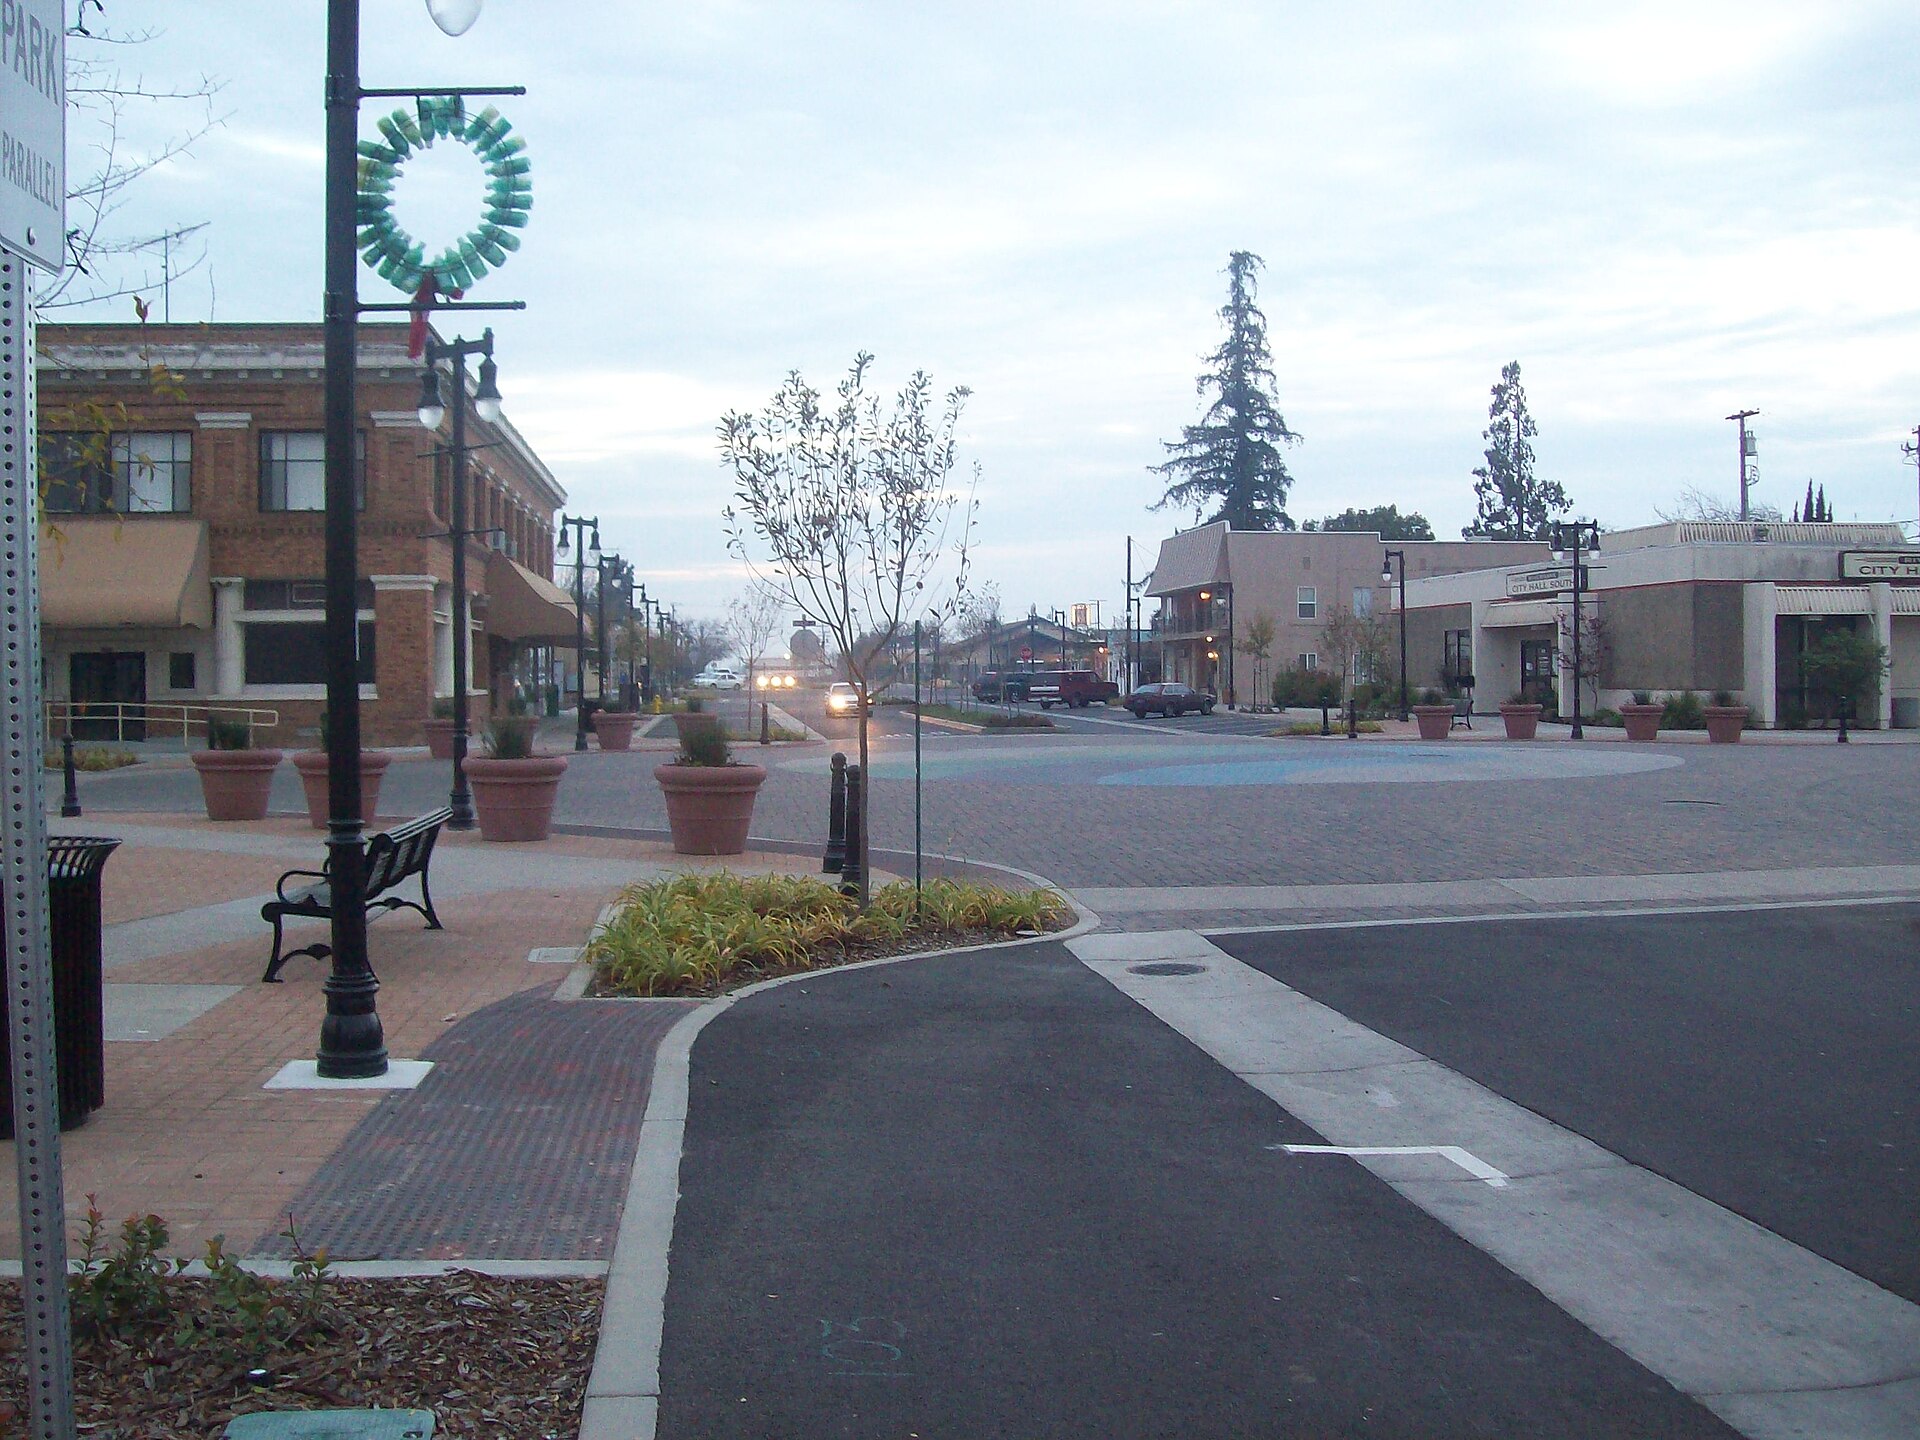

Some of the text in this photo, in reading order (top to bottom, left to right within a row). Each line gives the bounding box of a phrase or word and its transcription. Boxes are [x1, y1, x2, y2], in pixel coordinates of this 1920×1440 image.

[2, 0, 58, 106] PARK
[2, 129, 58, 211] PARALLEL
[1511, 584, 1528, 593] CITY
[1529, 581, 1548, 591] HALL
[1859, 565, 1900, 575] CITY
